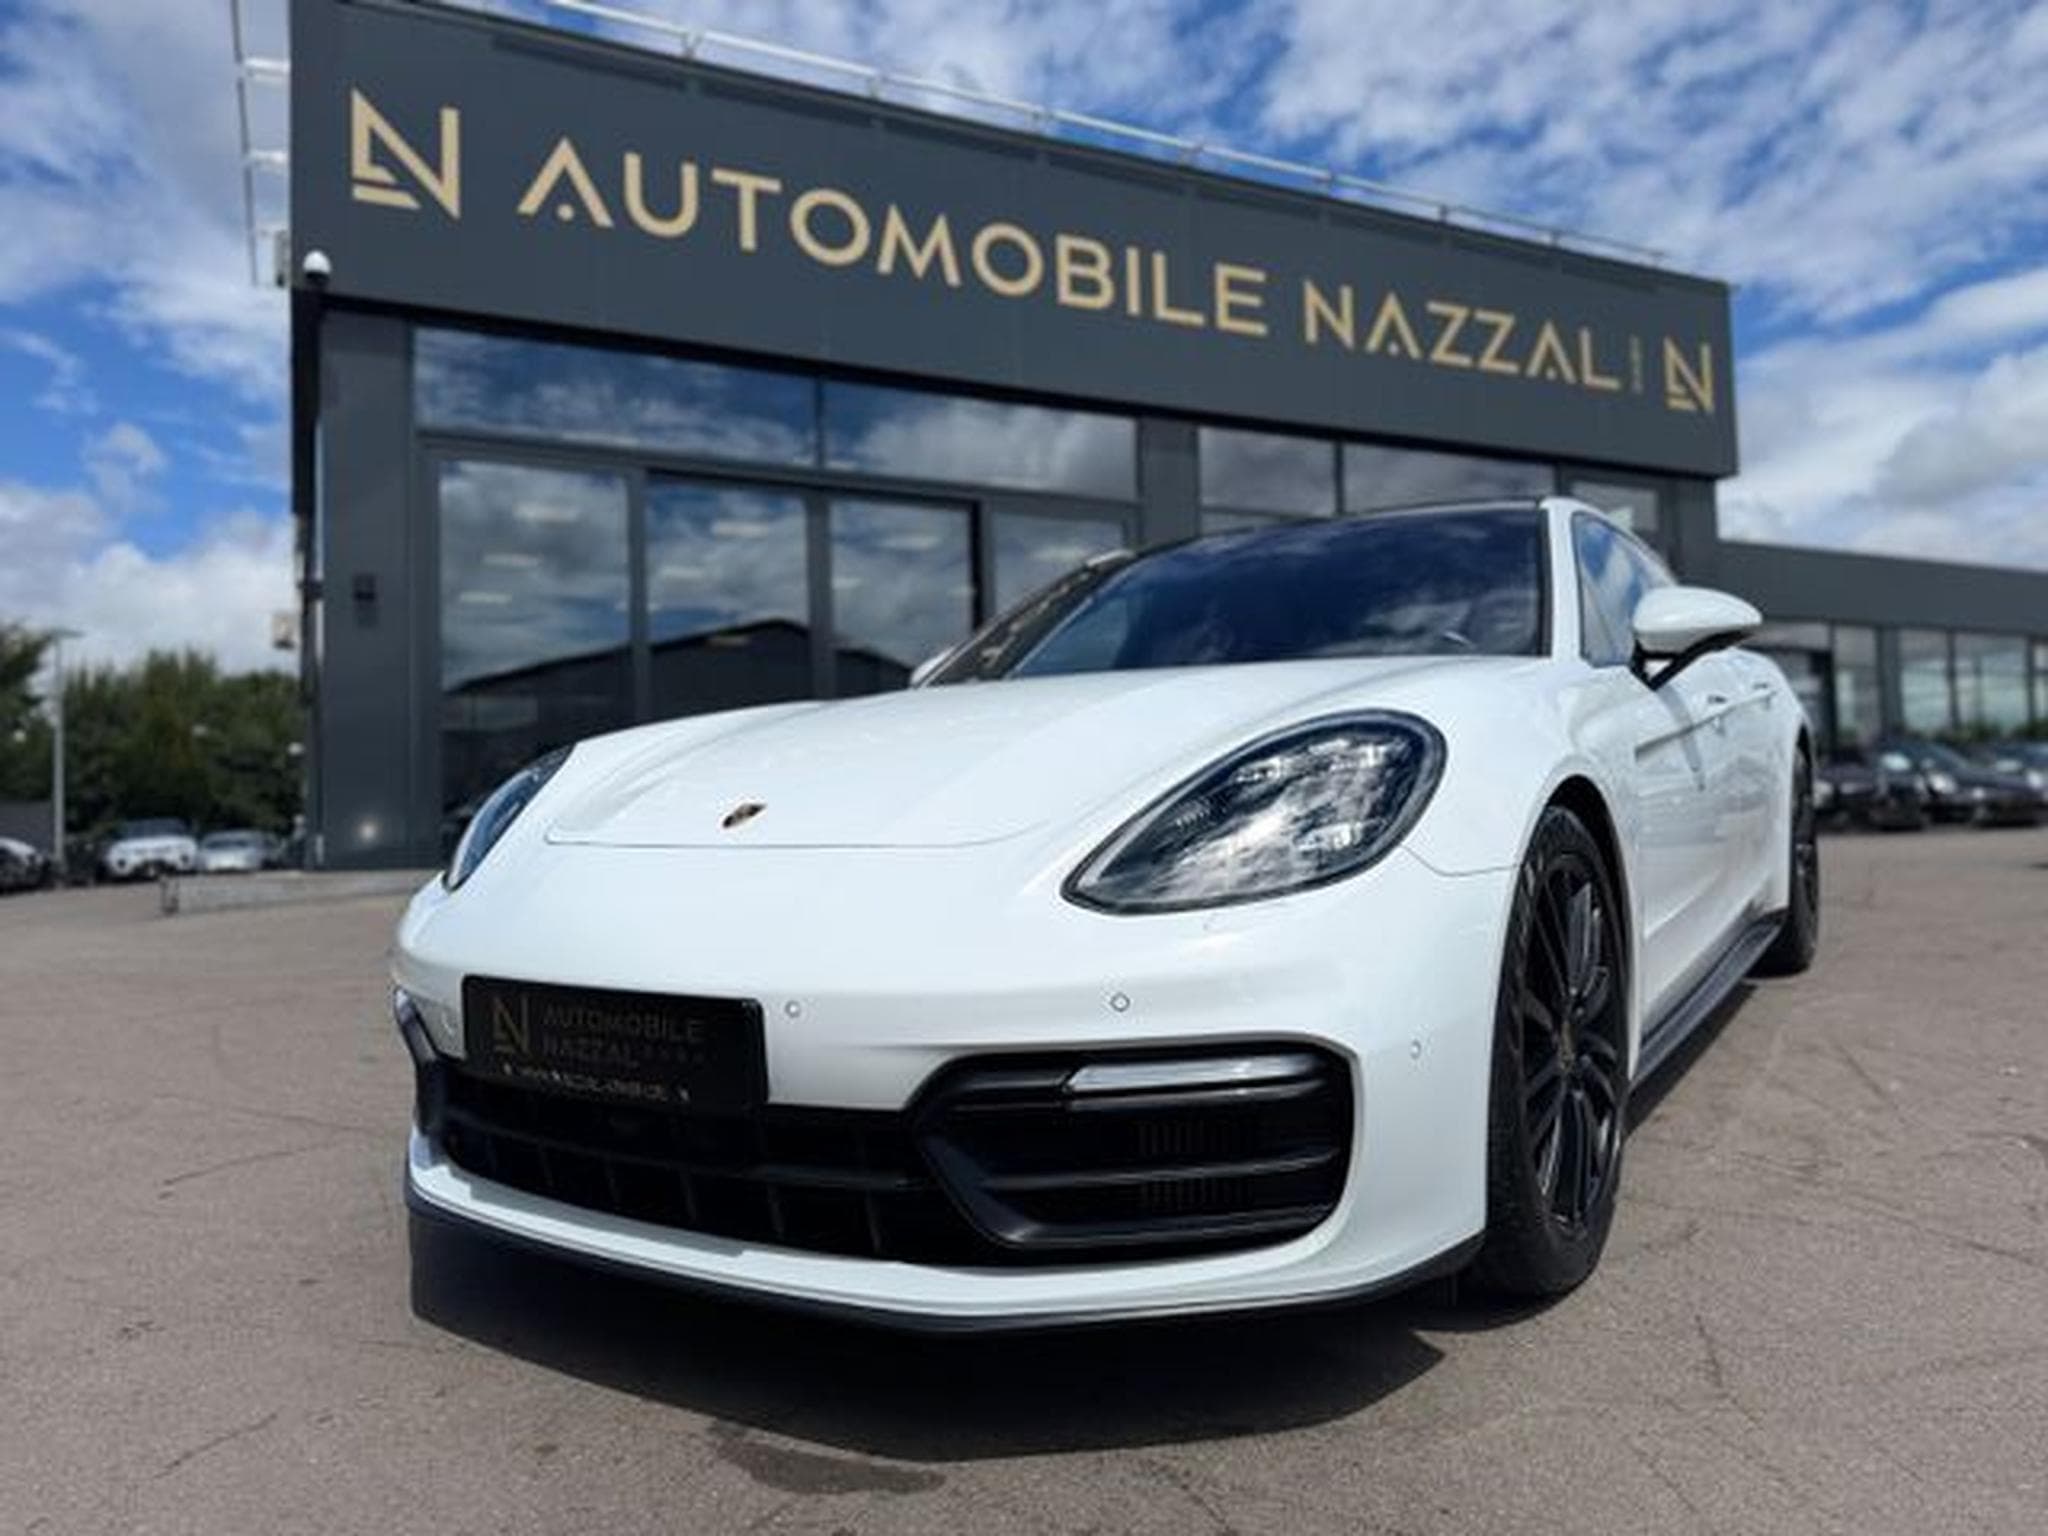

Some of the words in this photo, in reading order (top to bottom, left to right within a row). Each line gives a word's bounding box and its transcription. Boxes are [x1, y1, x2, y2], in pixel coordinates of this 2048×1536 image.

[516, 136, 1268, 338] AUTOMOBILE
[1303, 280, 1621, 392] NAZZAL
[543, 1003, 705, 1043] AUTOMOBILE
